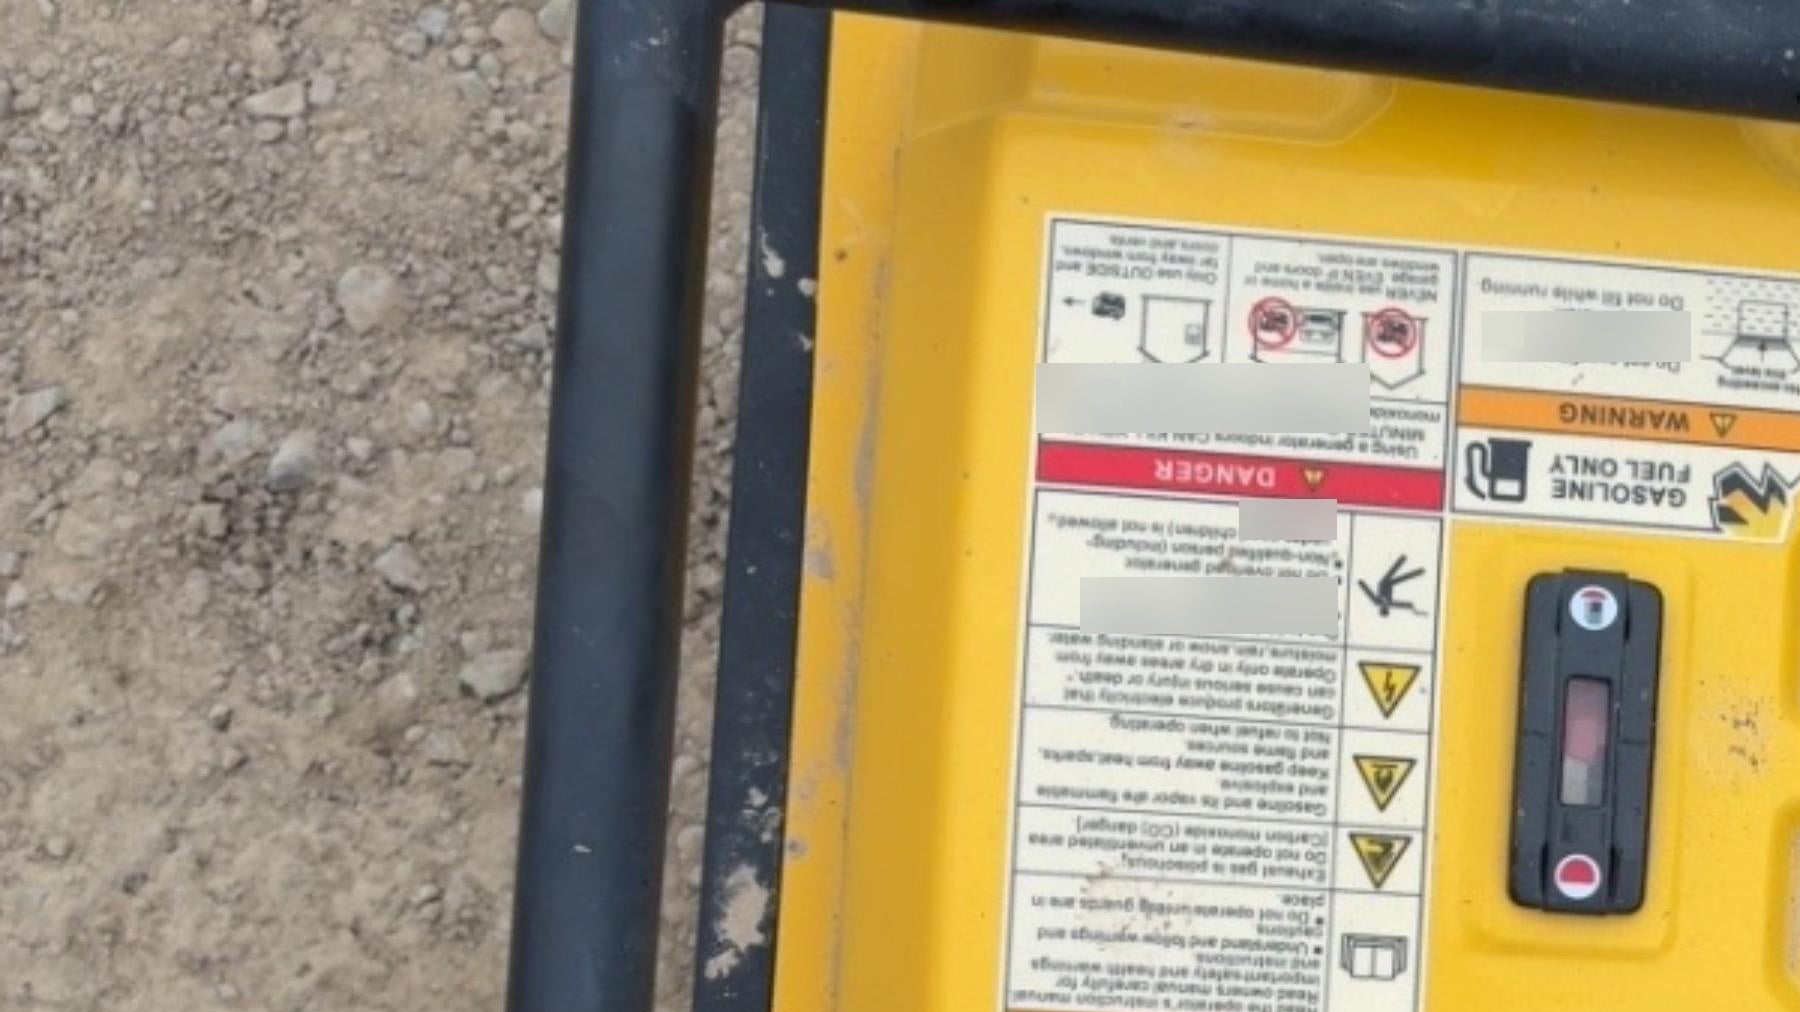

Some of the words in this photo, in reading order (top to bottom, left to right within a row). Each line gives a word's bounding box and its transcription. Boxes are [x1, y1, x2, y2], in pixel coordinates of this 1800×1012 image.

[1558, 403, 1690, 432] WARNING
[1154, 459, 1276, 488] DANGER
[1548, 454, 1617, 476] ONLY
[1625, 459, 1691, 482] FUEL
[1551, 478, 1686, 507] GASOLINE
